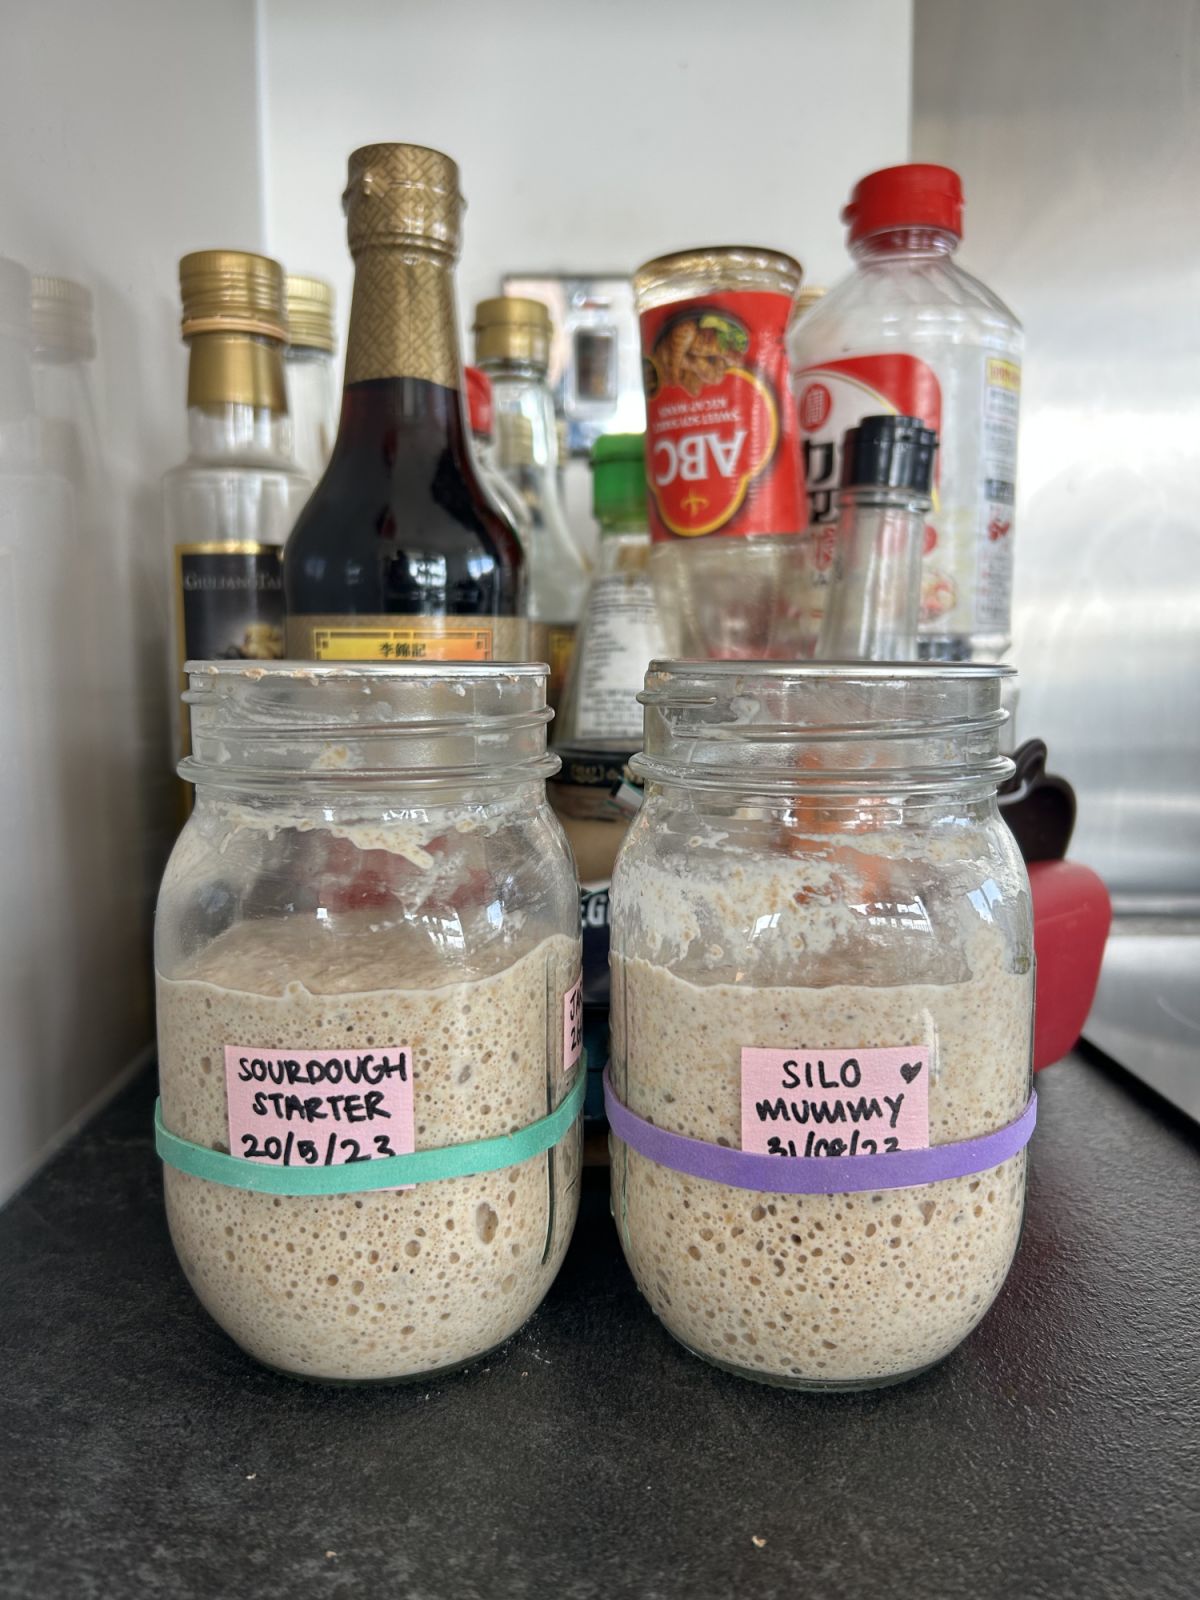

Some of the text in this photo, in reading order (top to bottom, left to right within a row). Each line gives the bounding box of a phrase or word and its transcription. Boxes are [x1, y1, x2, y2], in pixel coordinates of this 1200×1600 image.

[654, 430, 747, 486] ABC
[379, 642, 426, 658] 李錦記
[238, 1052, 407, 1085] SOURDOUGH
[782, 1058, 861, 1089] SILO
[252, 1090, 392, 1123] STARTER
[755, 1093, 905, 1128] MUMMY
